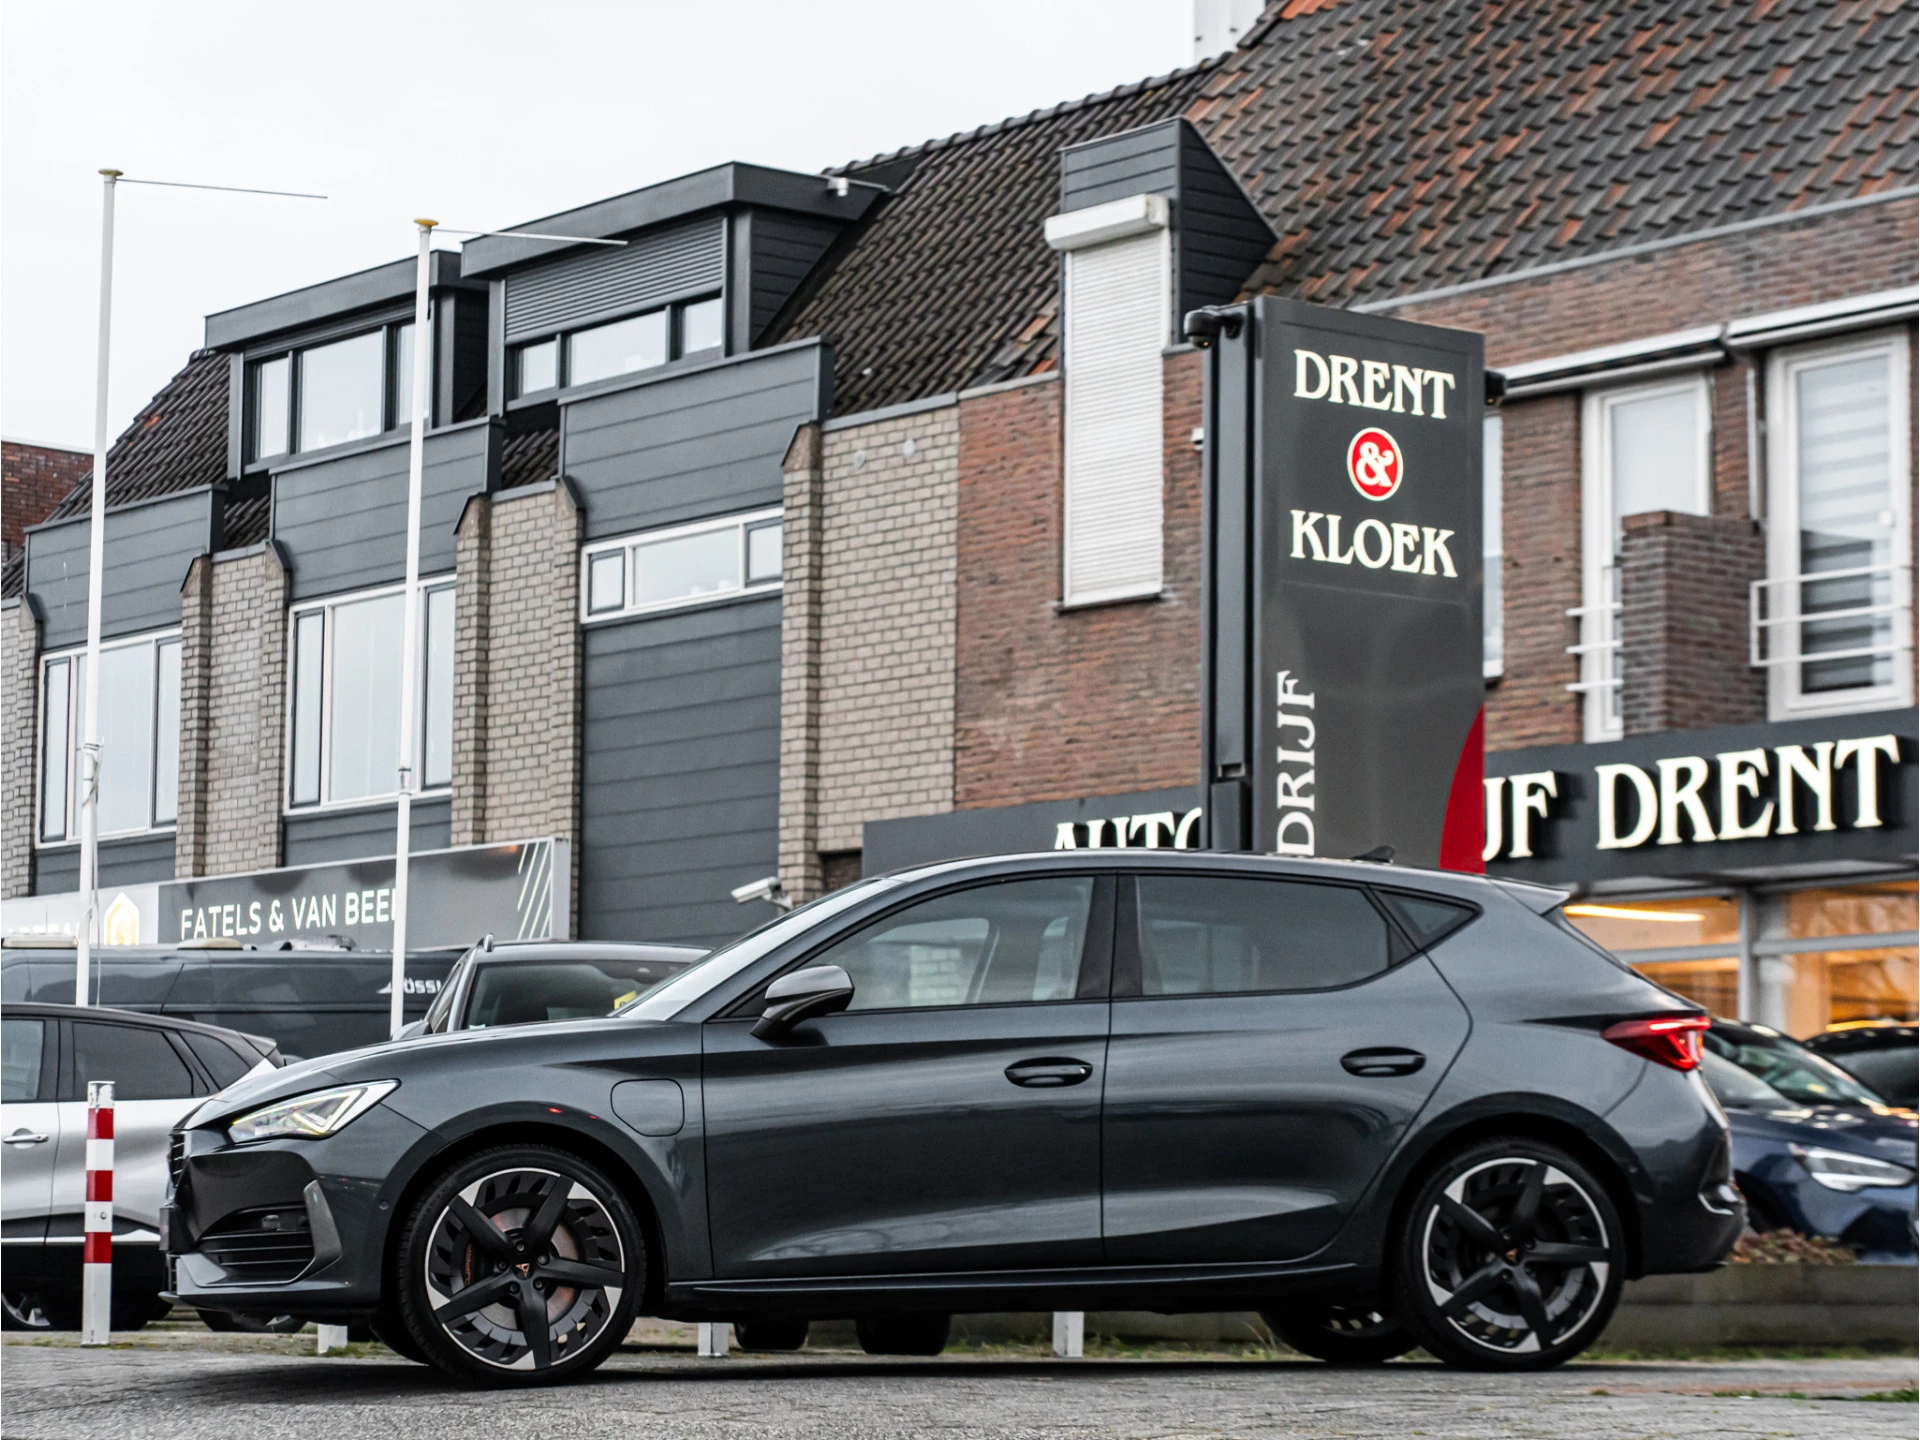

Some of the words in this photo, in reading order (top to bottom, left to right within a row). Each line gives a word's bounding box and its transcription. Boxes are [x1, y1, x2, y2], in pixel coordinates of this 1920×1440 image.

[1293, 349, 1455, 419] DRENT
[1353, 439, 1396, 489] &
[1290, 509, 1458, 578] KLOEK
[1595, 734, 1900, 850] DRENT
[181, 901, 262, 940] FATELS
[268, 899, 284, 933] &
[292, 893, 337, 930] VAN
[345, 888, 396, 926] BEE
